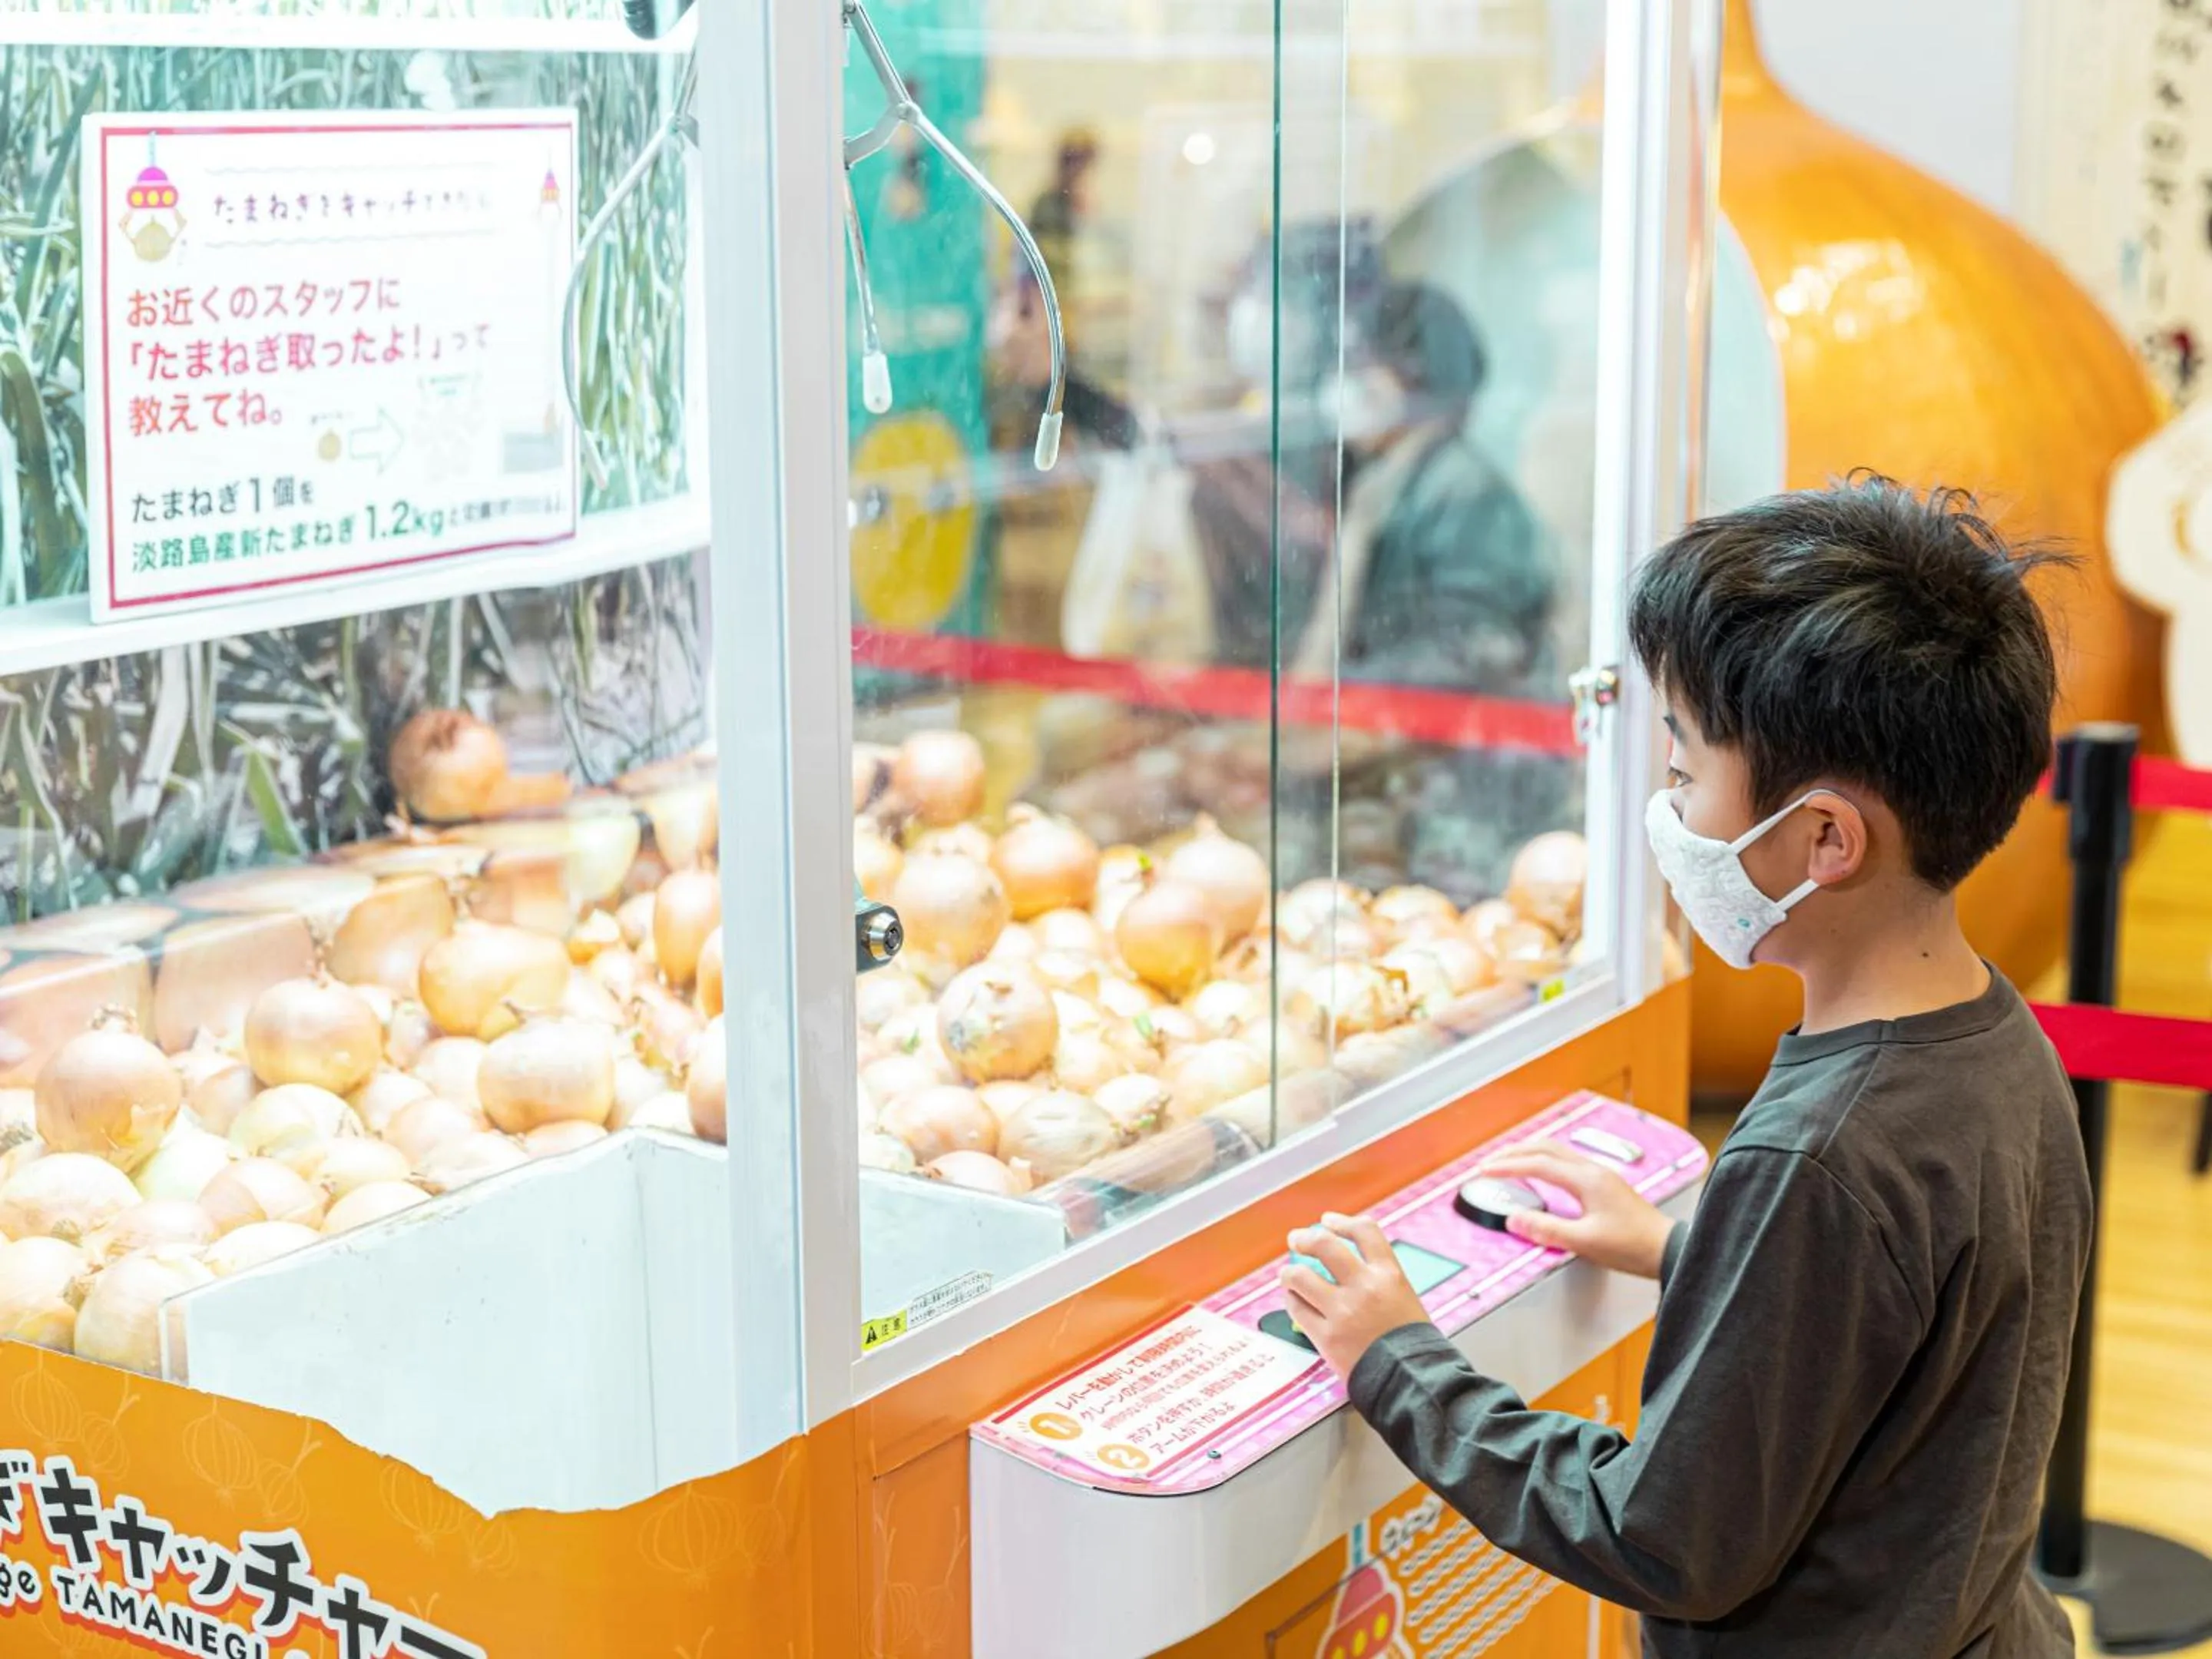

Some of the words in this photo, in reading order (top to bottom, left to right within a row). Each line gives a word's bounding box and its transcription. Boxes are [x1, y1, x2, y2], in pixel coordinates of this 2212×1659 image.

[127, 277, 402, 327] お近くのスタッフに
[128, 388, 283, 438] 教えてね。
[1038, 1419, 1071, 1435] 1
[1108, 1448, 1139, 1466] 2
